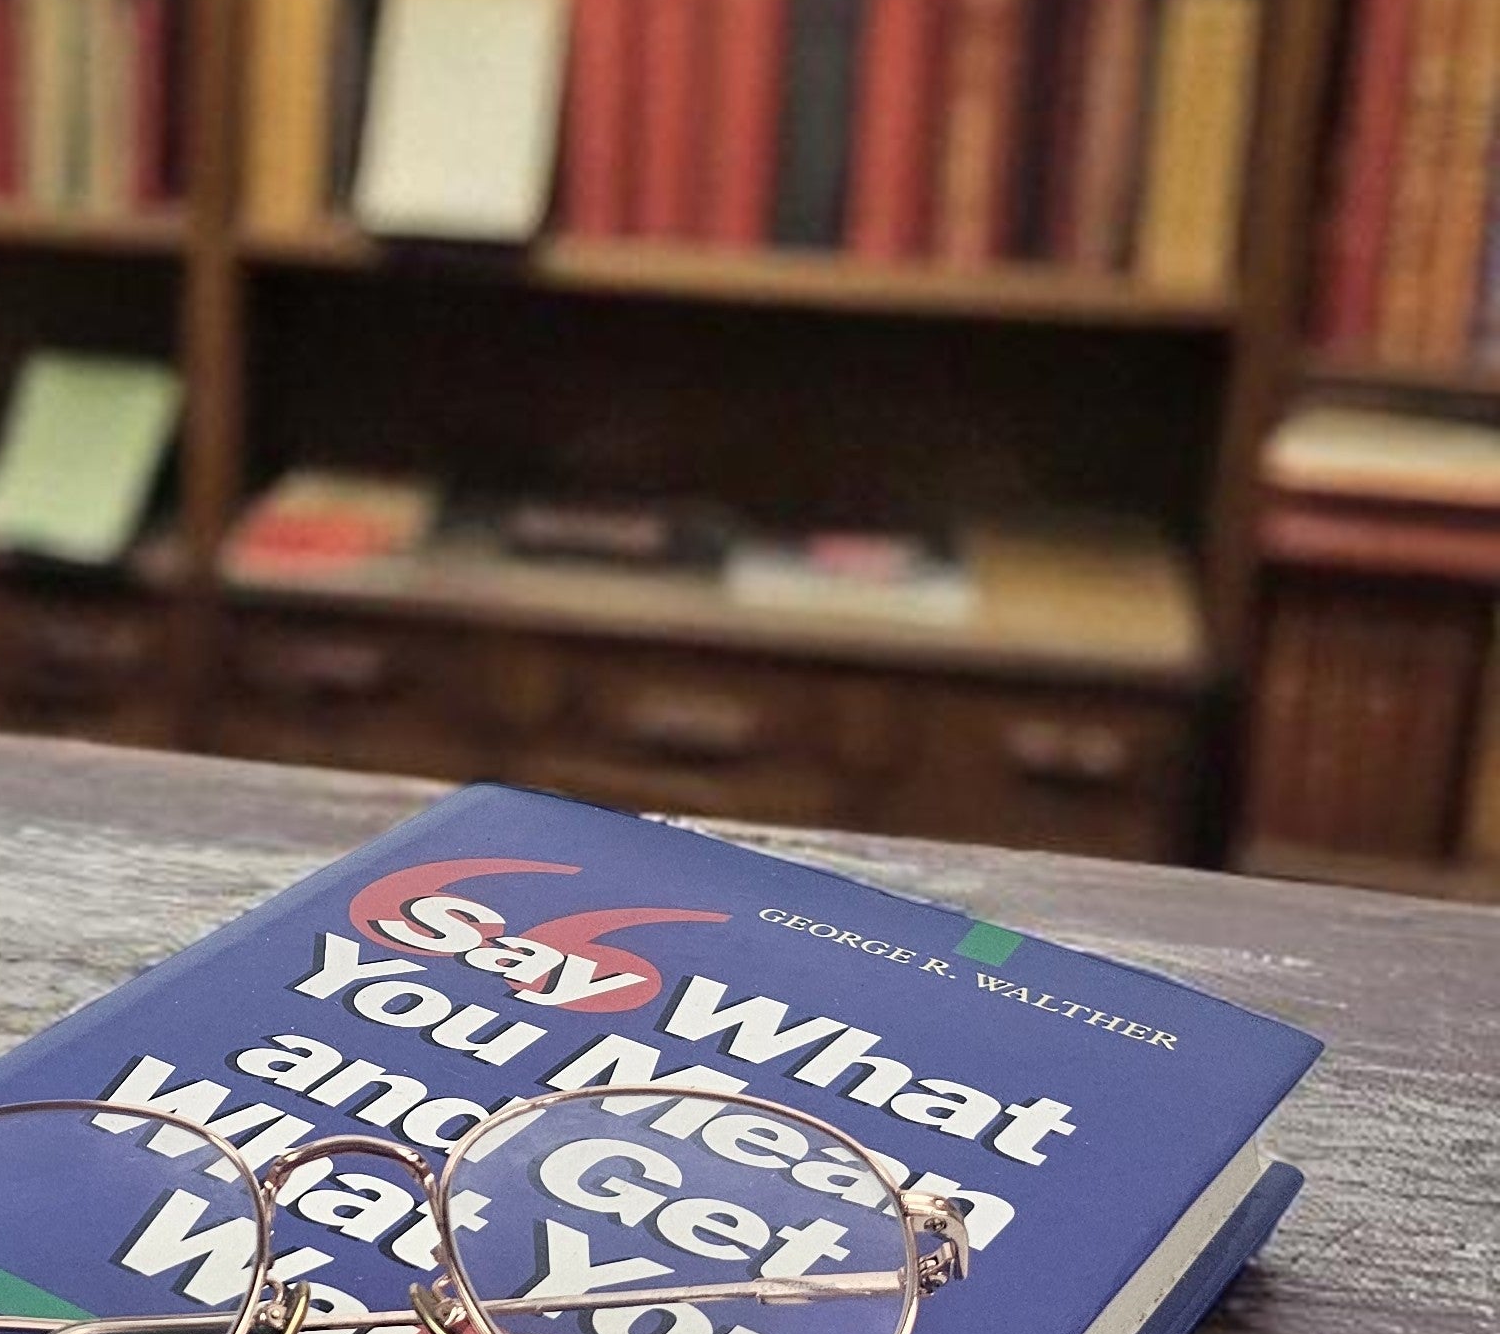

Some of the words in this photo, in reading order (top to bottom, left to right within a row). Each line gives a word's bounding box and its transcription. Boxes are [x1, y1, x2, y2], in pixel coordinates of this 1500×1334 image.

[293, 931, 549, 1067] You
[545, 1033, 1016, 1252] Mean
[378, 895, 648, 1007] Say
[664, 974, 1078, 1167] What
[758, 908, 917, 965] GEORGE
[918, 957, 957, 979] R.
[975, 972, 1180, 1052] WALTHER
[91, 1054, 492, 1272] What
[236, 1034, 548, 1164] and
[539, 1137, 851, 1280] Get
